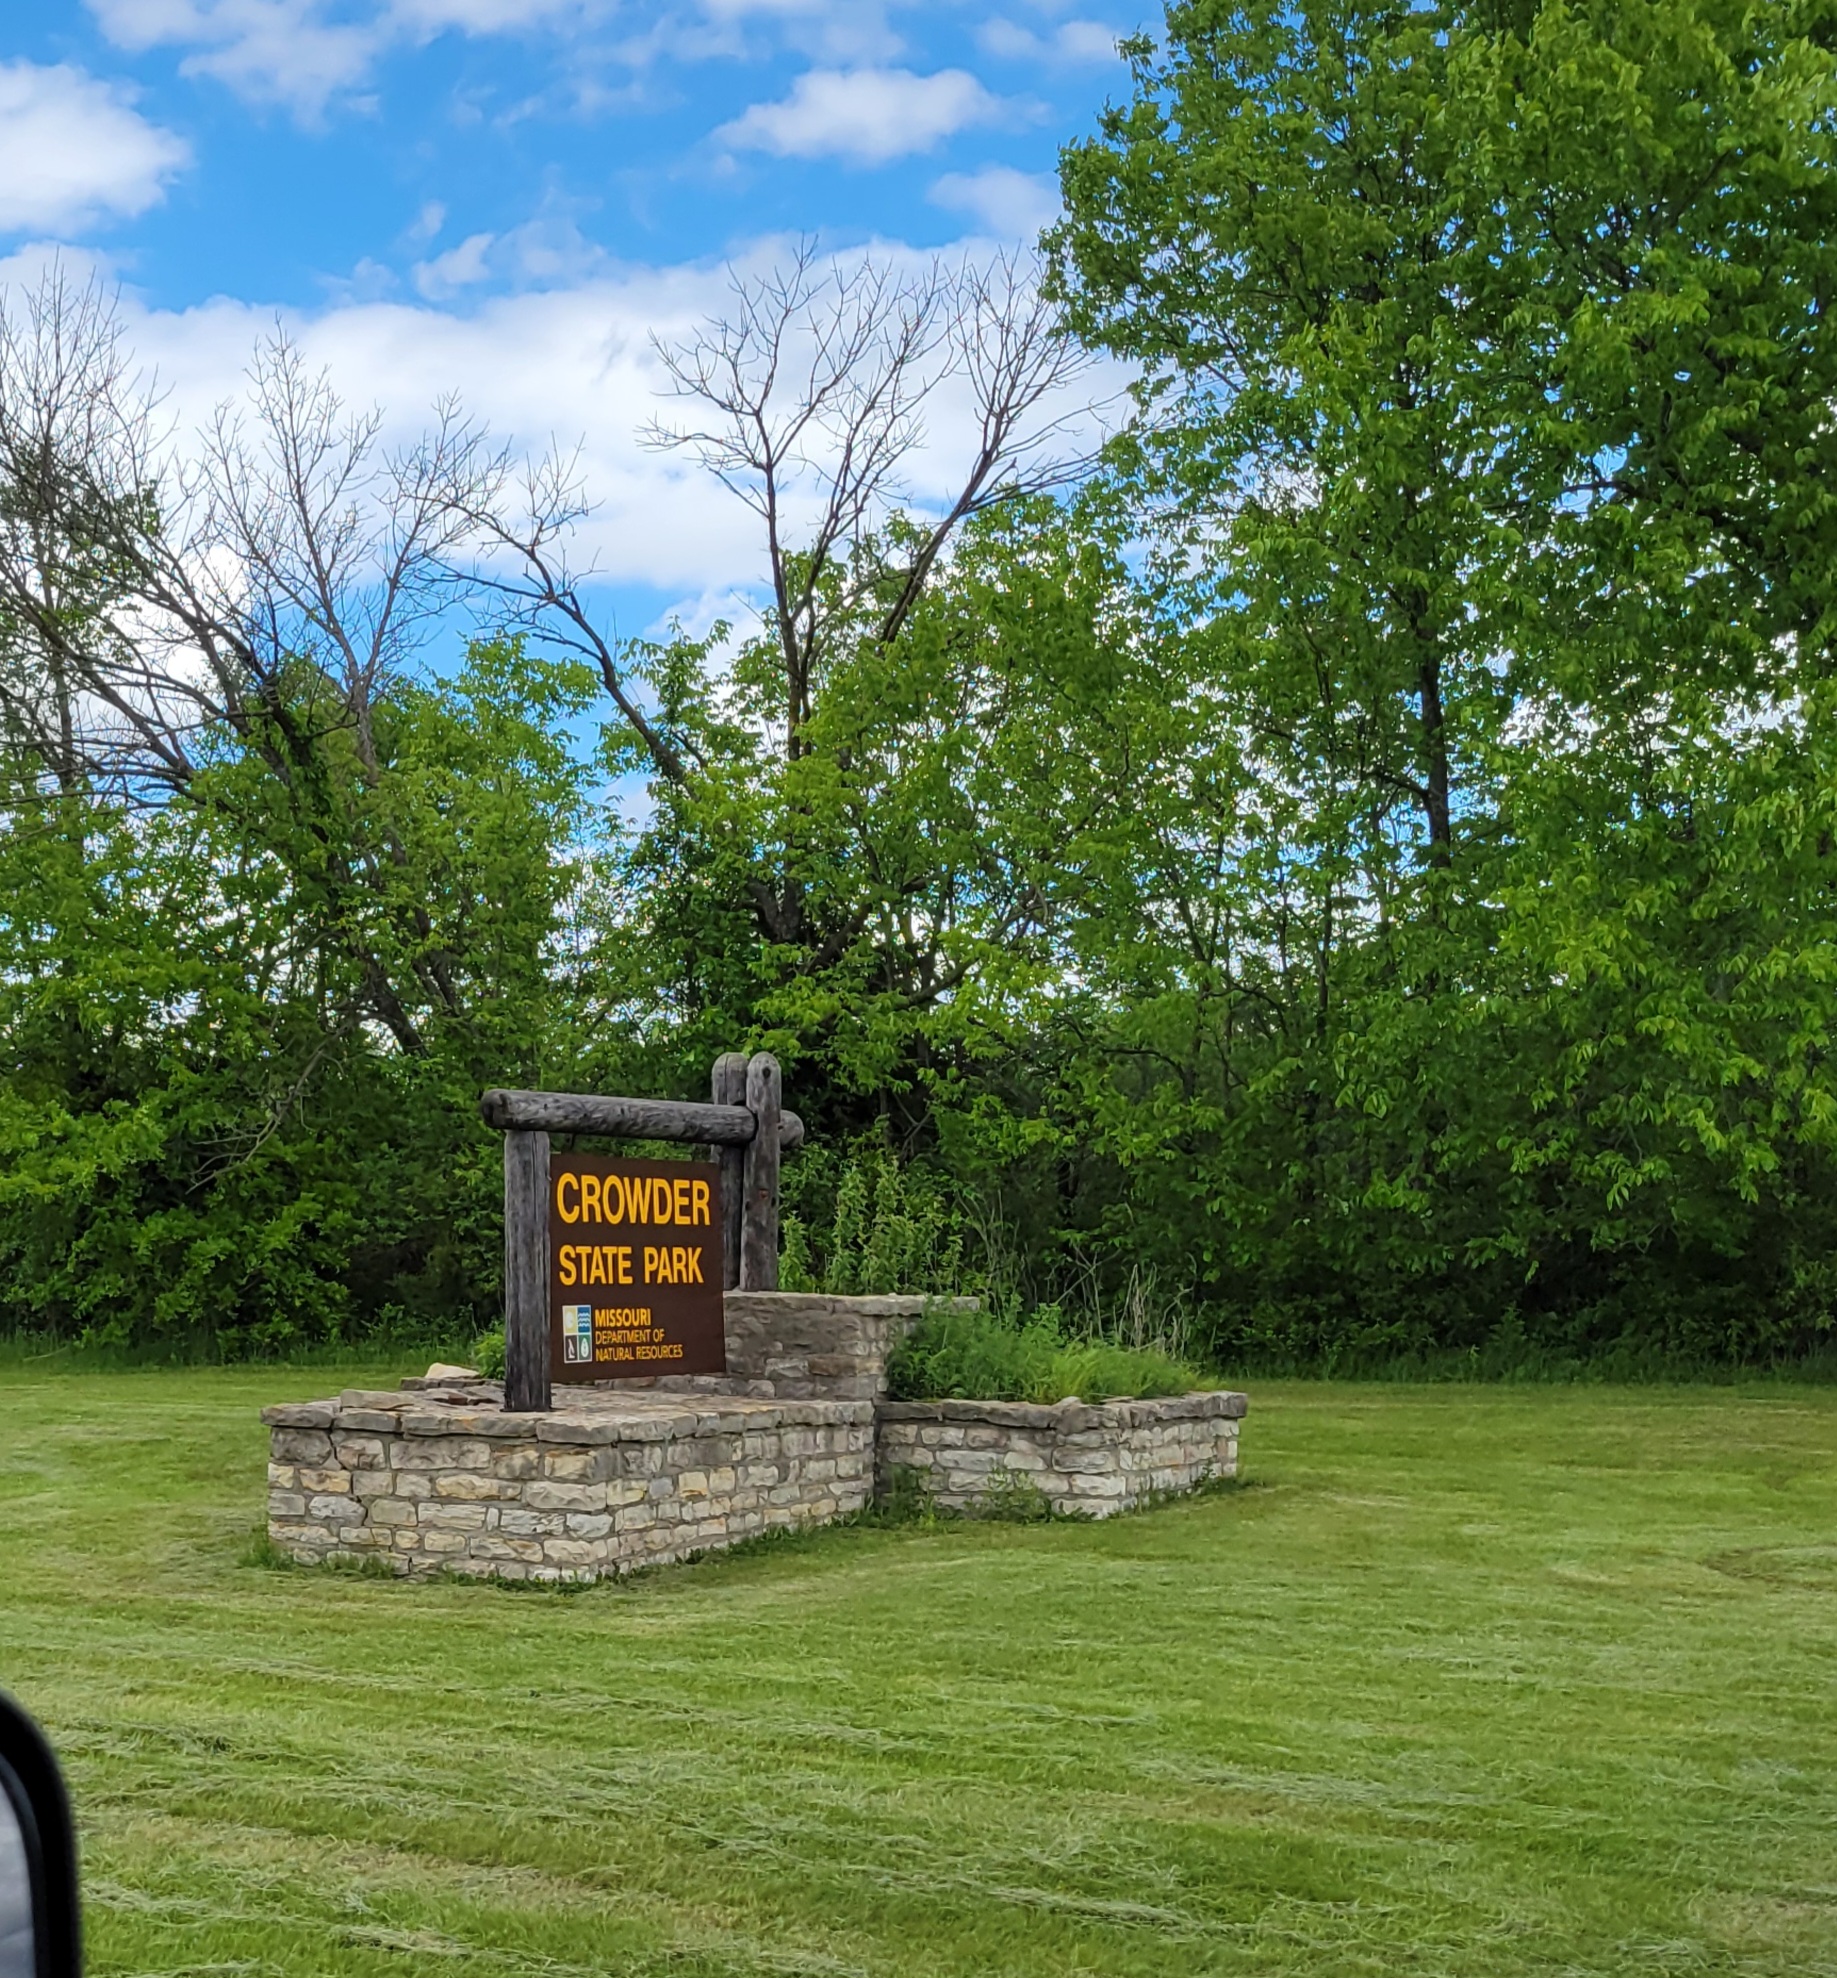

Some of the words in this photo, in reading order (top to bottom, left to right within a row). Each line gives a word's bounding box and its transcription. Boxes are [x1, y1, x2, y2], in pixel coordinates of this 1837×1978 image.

[556, 1172, 711, 1226] CROWDER
[559, 1244, 633, 1286] STATE
[643, 1246, 704, 1285] PARK
[594, 1307, 652, 1328] MISSOURI
[595, 1328, 652, 1345] DEPARTMENT
[652, 1328, 665, 1343] OF
[595, 1346, 635, 1362] NATURAL
[635, 1344, 684, 1360] RESOURCES
